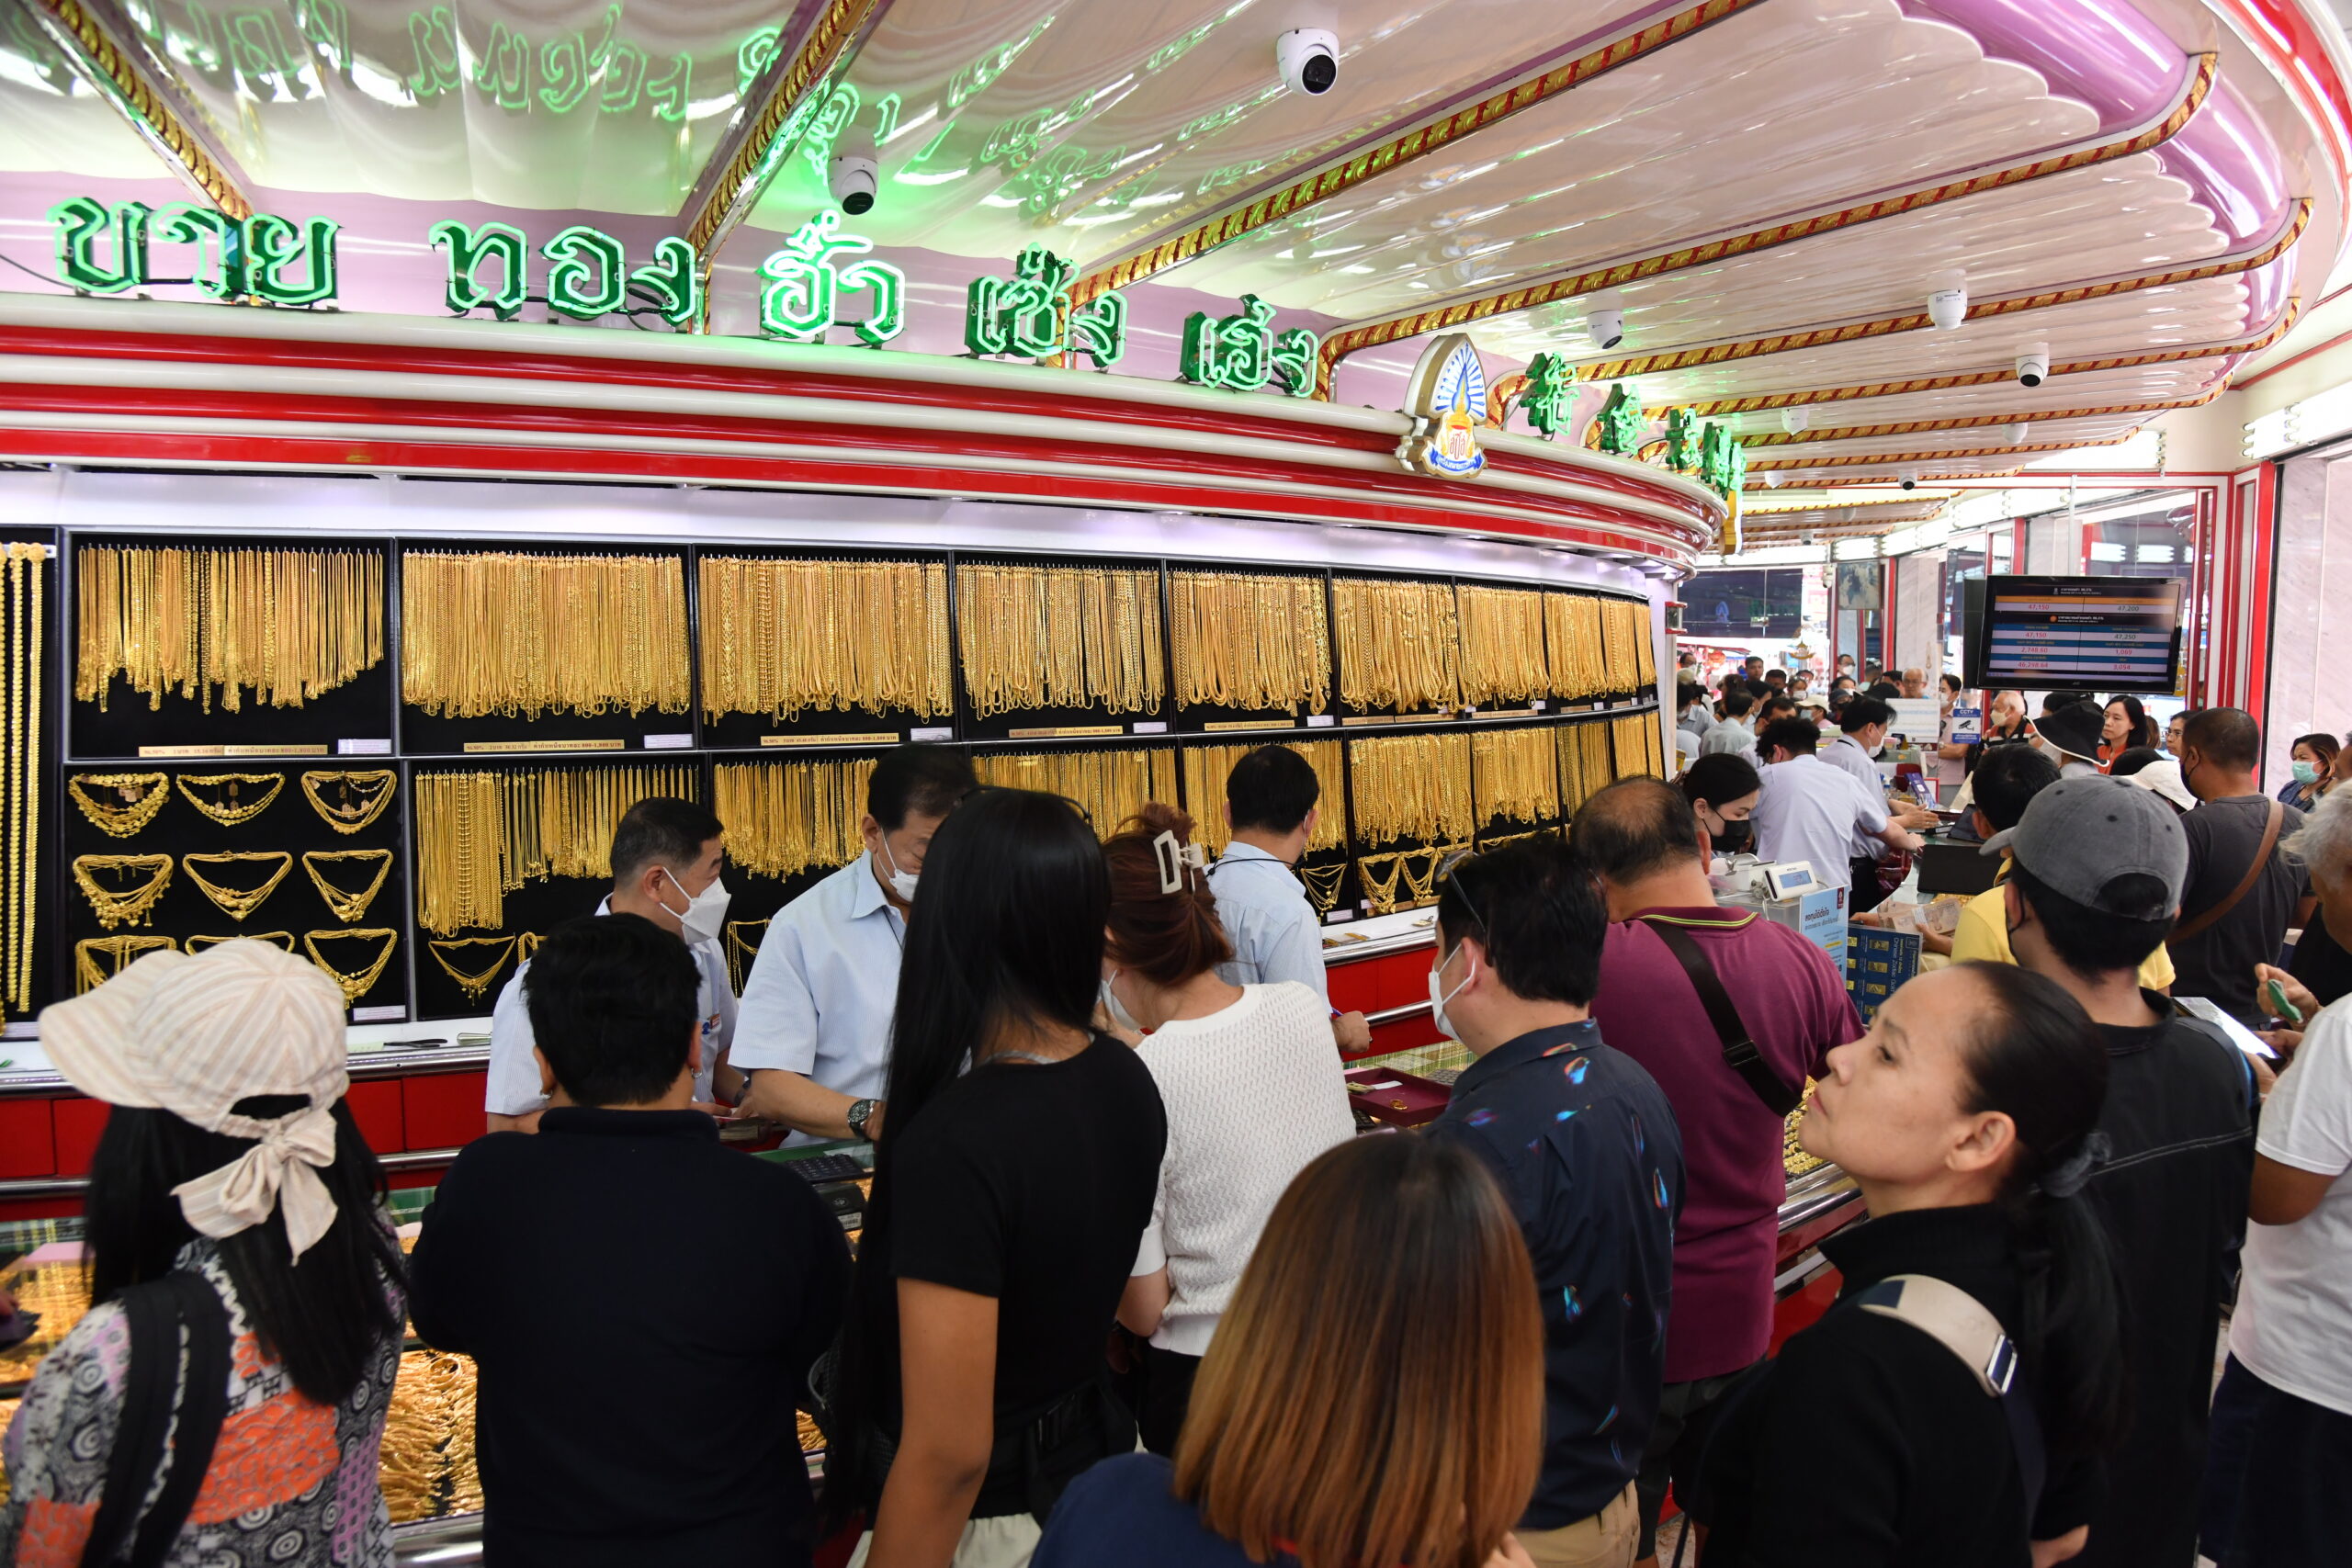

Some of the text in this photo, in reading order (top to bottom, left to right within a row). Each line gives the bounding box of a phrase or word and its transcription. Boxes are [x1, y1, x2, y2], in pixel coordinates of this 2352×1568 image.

[46, 197, 342, 309] ขาย
[429, 220, 697, 323] ทอง
[966, 243, 1127, 366] เซ่ง
